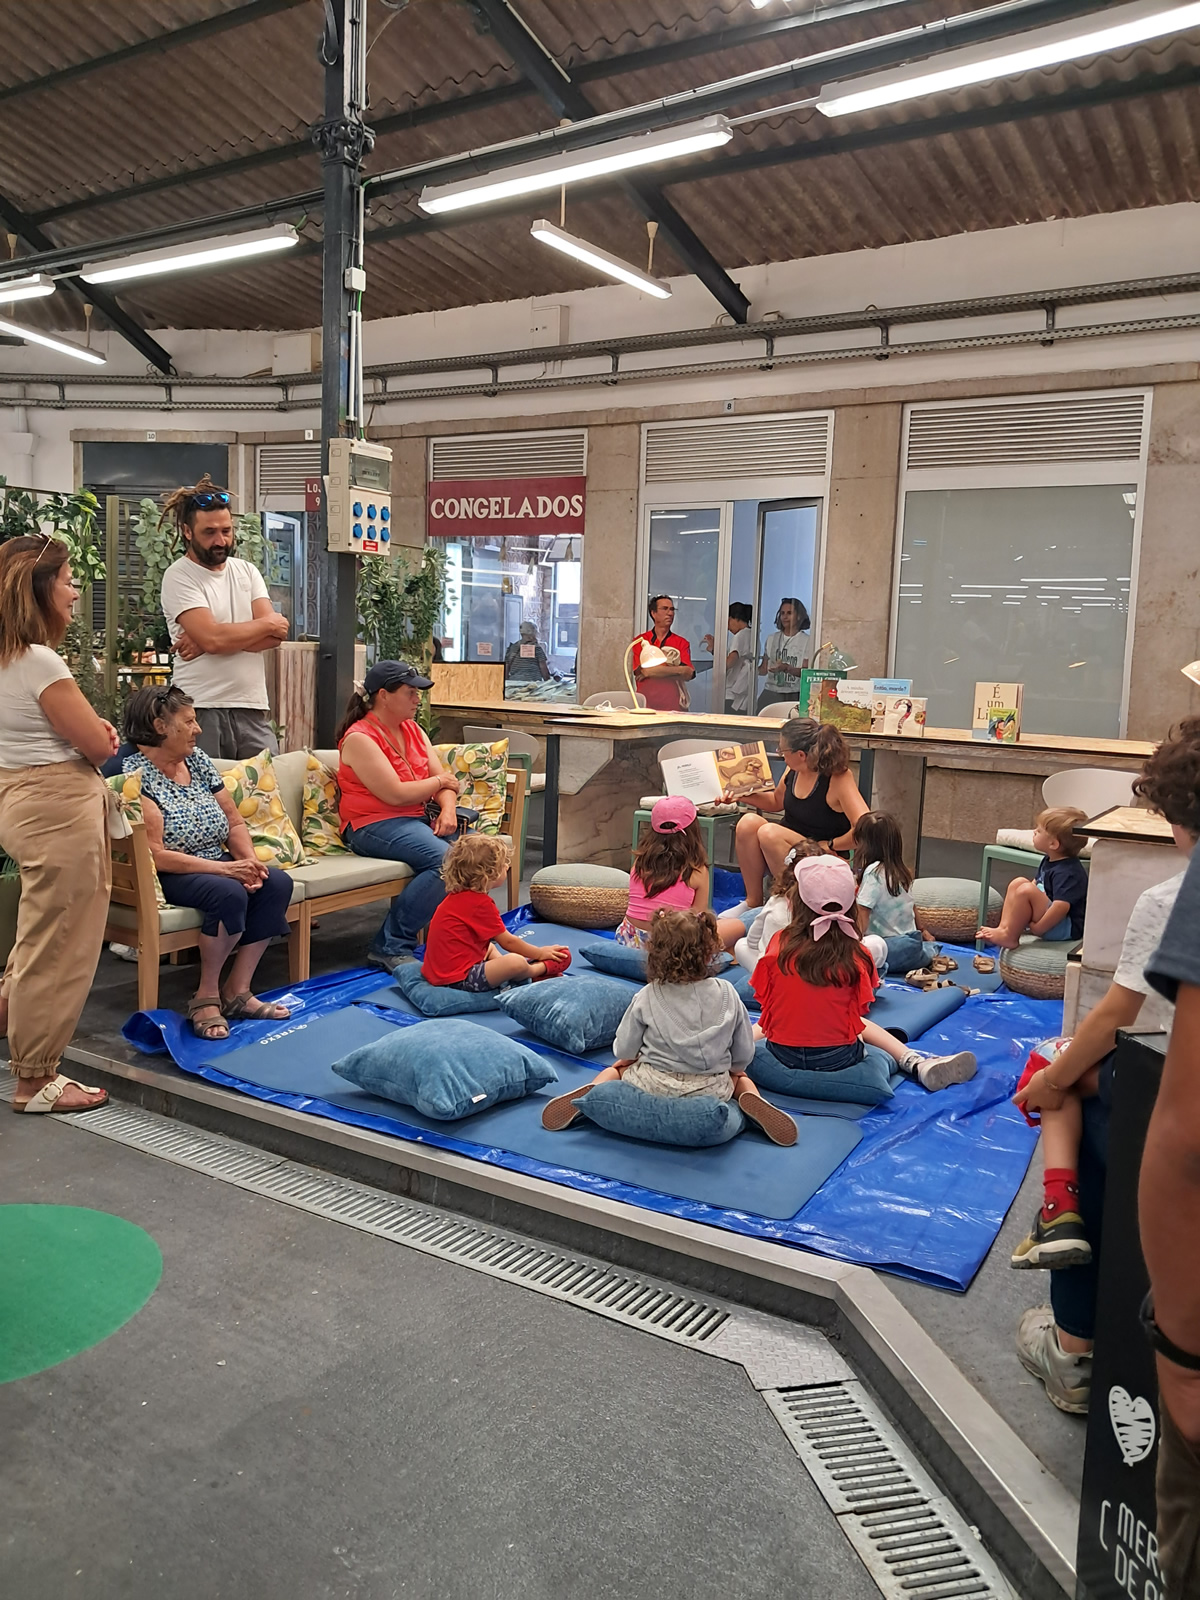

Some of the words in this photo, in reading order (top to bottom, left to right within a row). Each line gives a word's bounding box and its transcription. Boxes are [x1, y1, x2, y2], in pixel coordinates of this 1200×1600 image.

[727, 402, 732, 410] 8
[315, 497, 321, 506] 9
[430, 494, 583, 519] CONGELADOS
[992, 684, 1001, 699] É
[987, 700, 1004, 708] um
[977, 708, 989, 720] Li
[1117, 1502, 1167, 1586] MER
[1114, 1544, 1140, 1600] DE
